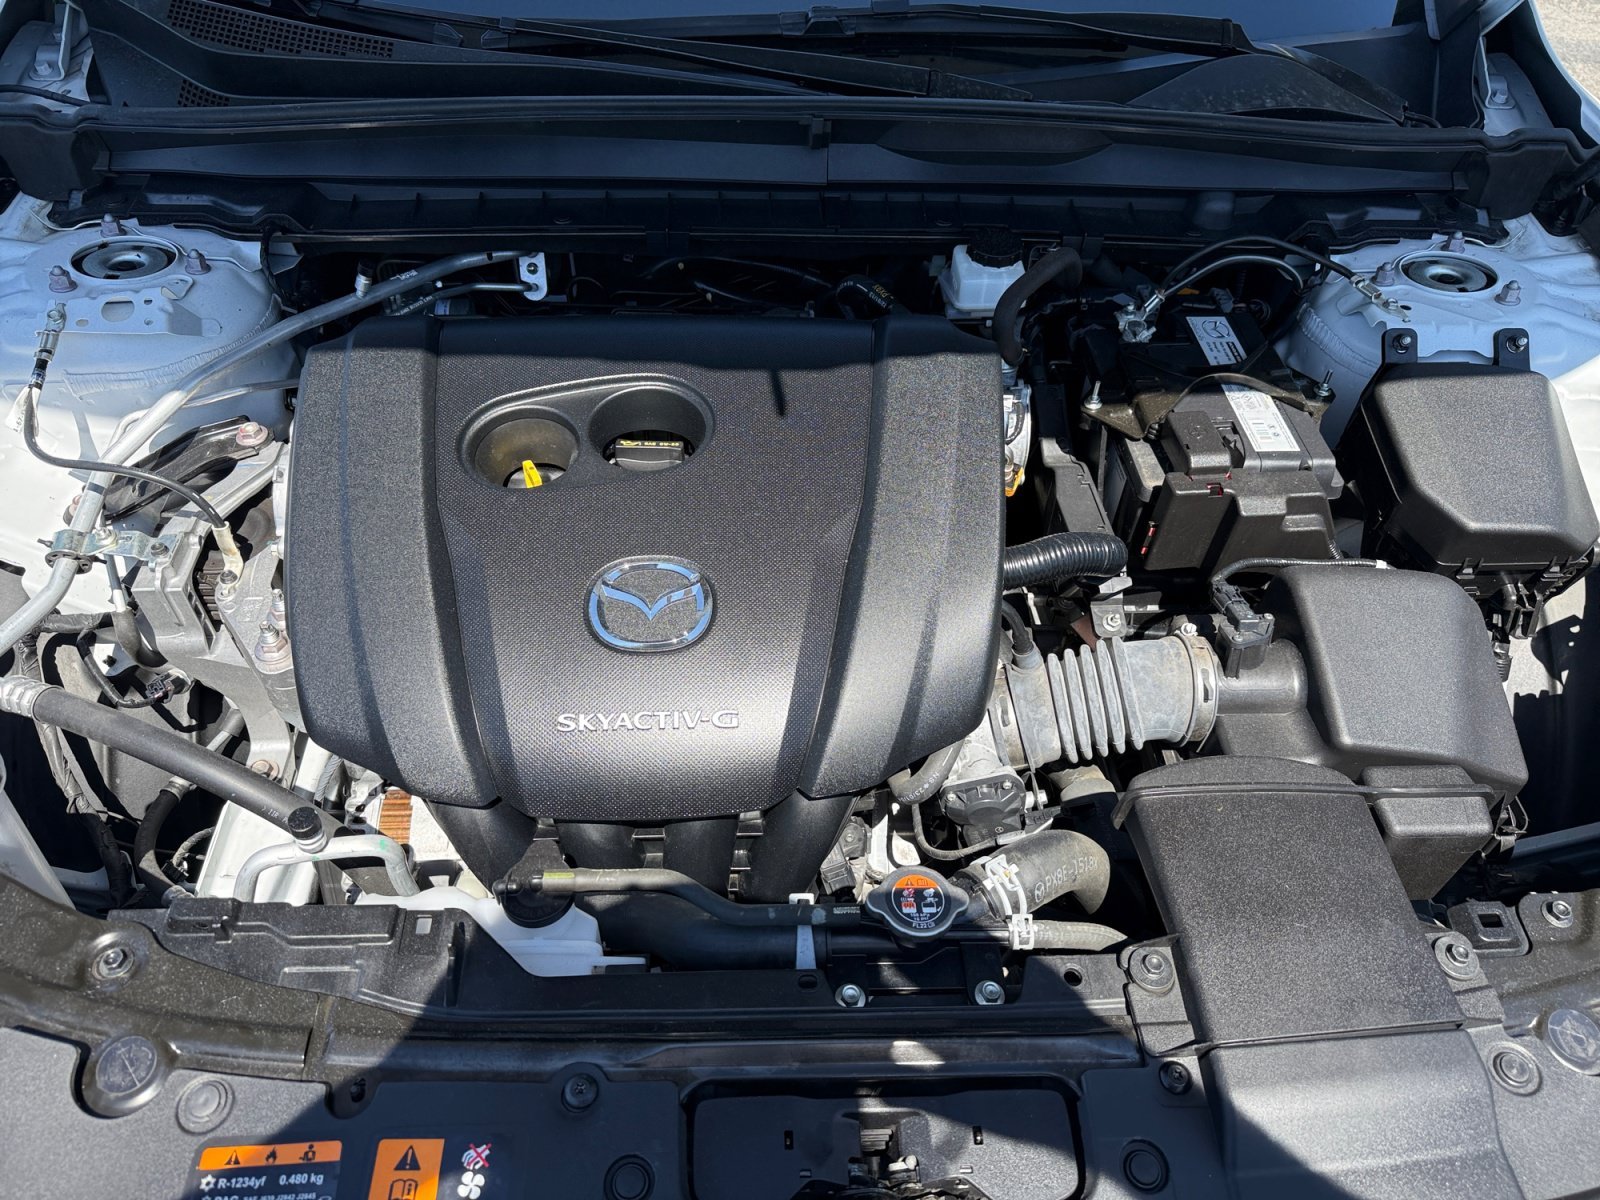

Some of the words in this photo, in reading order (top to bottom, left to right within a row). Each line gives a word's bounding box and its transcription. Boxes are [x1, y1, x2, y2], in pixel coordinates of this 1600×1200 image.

[557, 709, 739, 732] SKYACTIV-G
[217, 1175, 267, 1190] R-1234yf
[279, 1173, 308, 1186] 0.480
[310, 1173, 324, 1186] kg
